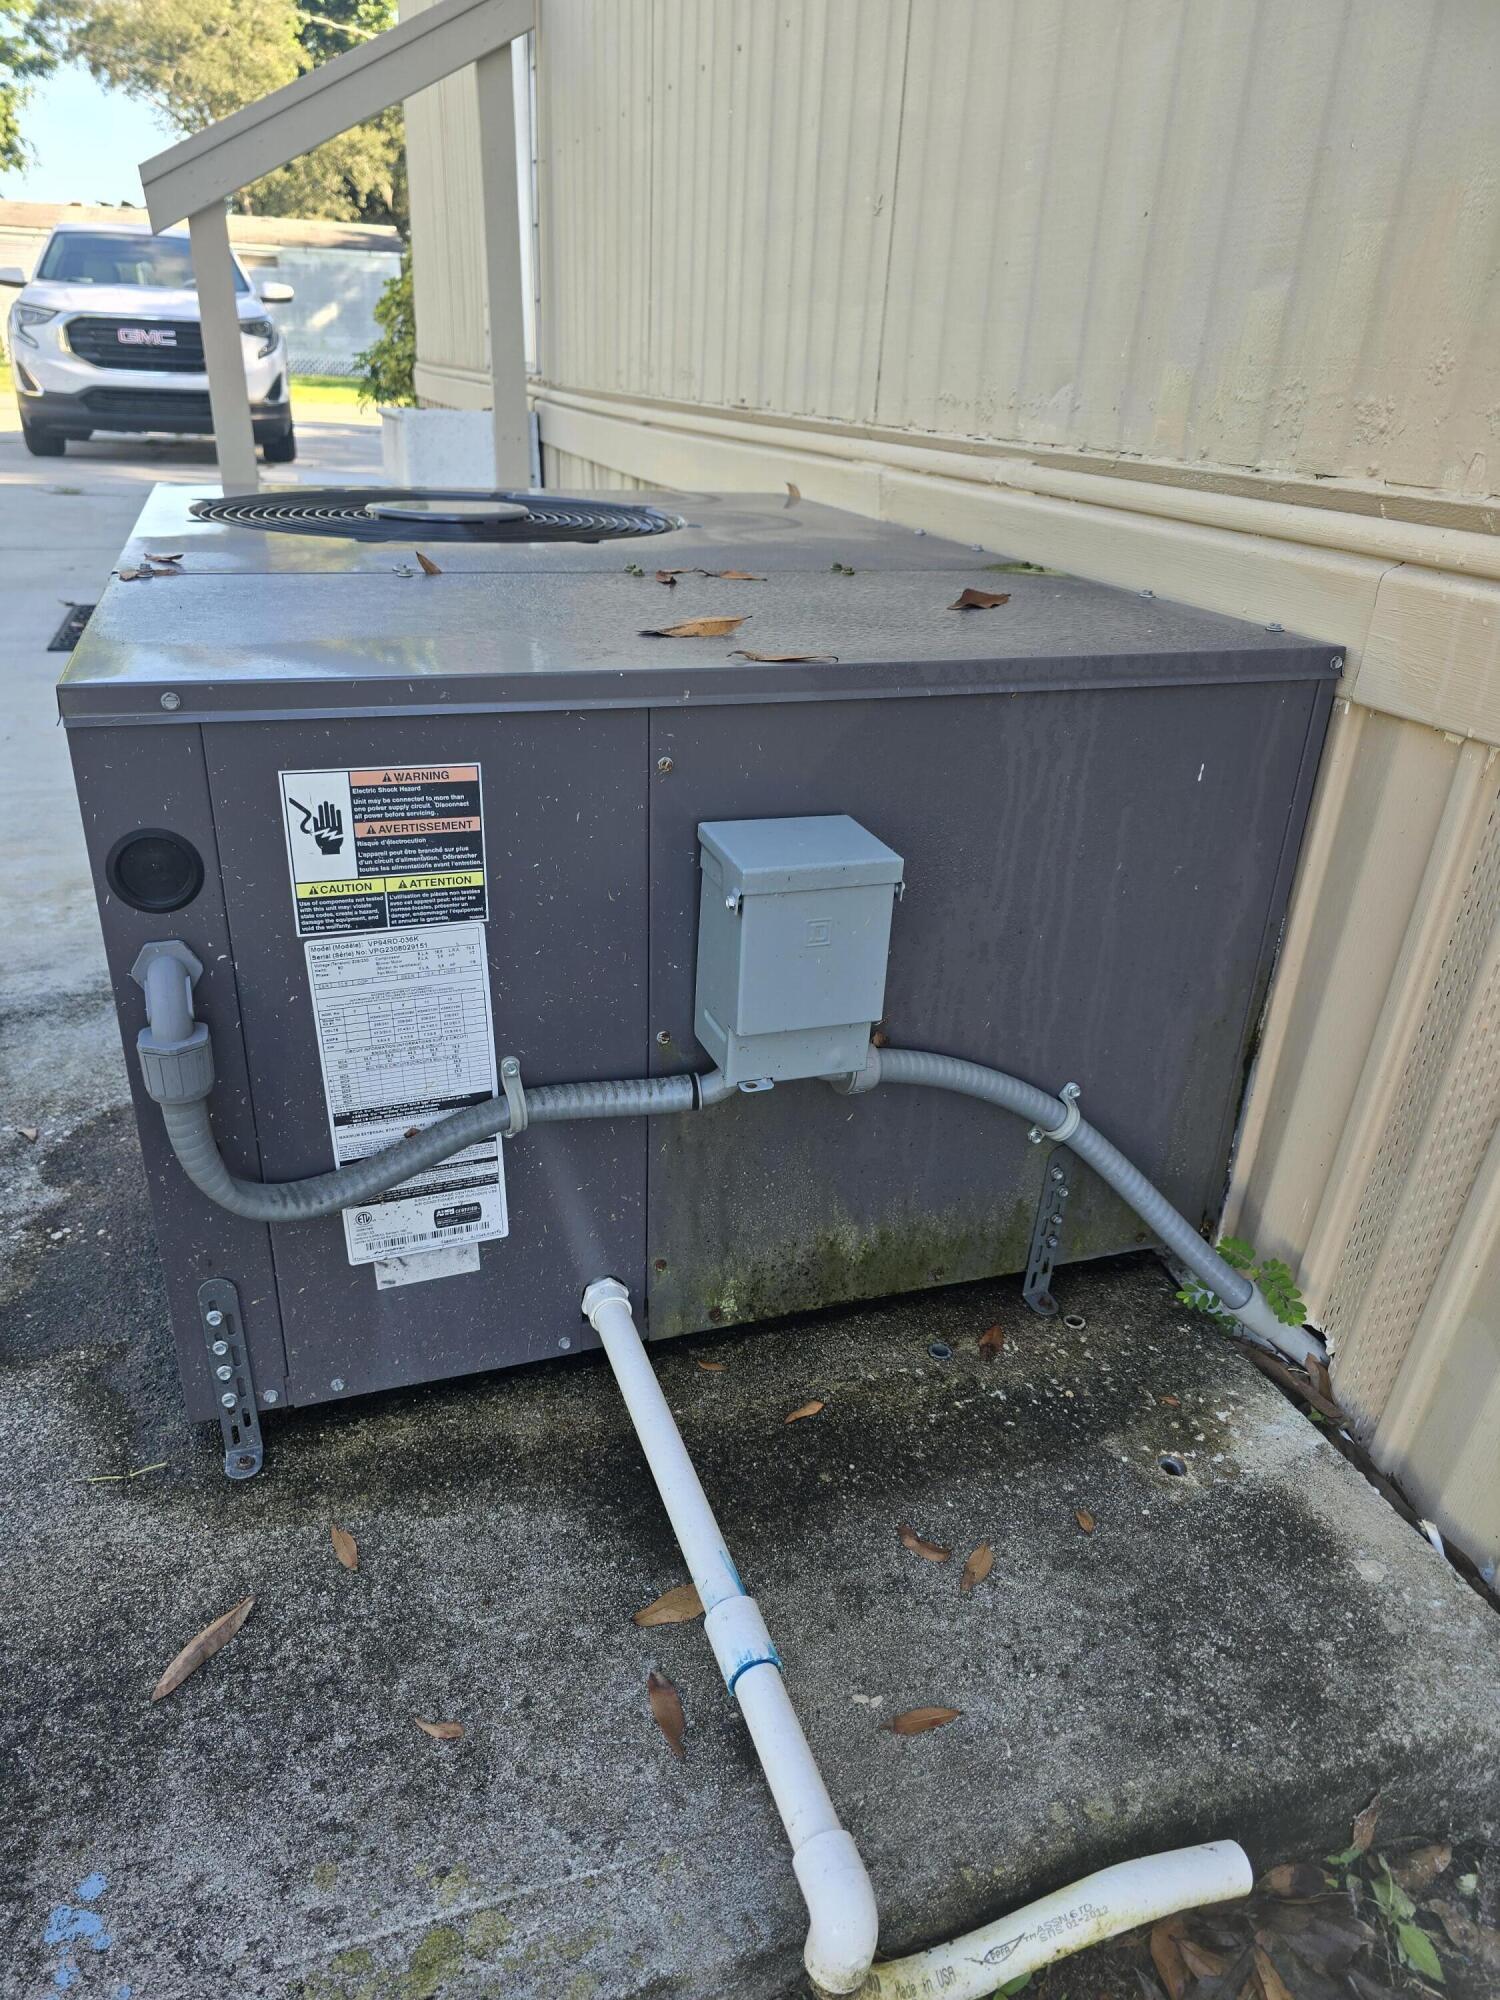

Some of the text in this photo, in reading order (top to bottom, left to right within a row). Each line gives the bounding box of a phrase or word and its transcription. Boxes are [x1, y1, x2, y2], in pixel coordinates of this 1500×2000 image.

[117, 328, 177, 346] GMC
[394, 771, 449, 782] WARNING
[379, 820, 472, 834] AVERTISSEMENT
[381, 838, 426, 846] d'électrocution
[320, 883, 372, 894] CAUTION
[410, 876, 472, 888] ATTENTION
[991, 1946, 1010, 1960] PPFA
[894, 1980, 917, 1999] Made
[935, 1966, 956, 1988] USA
